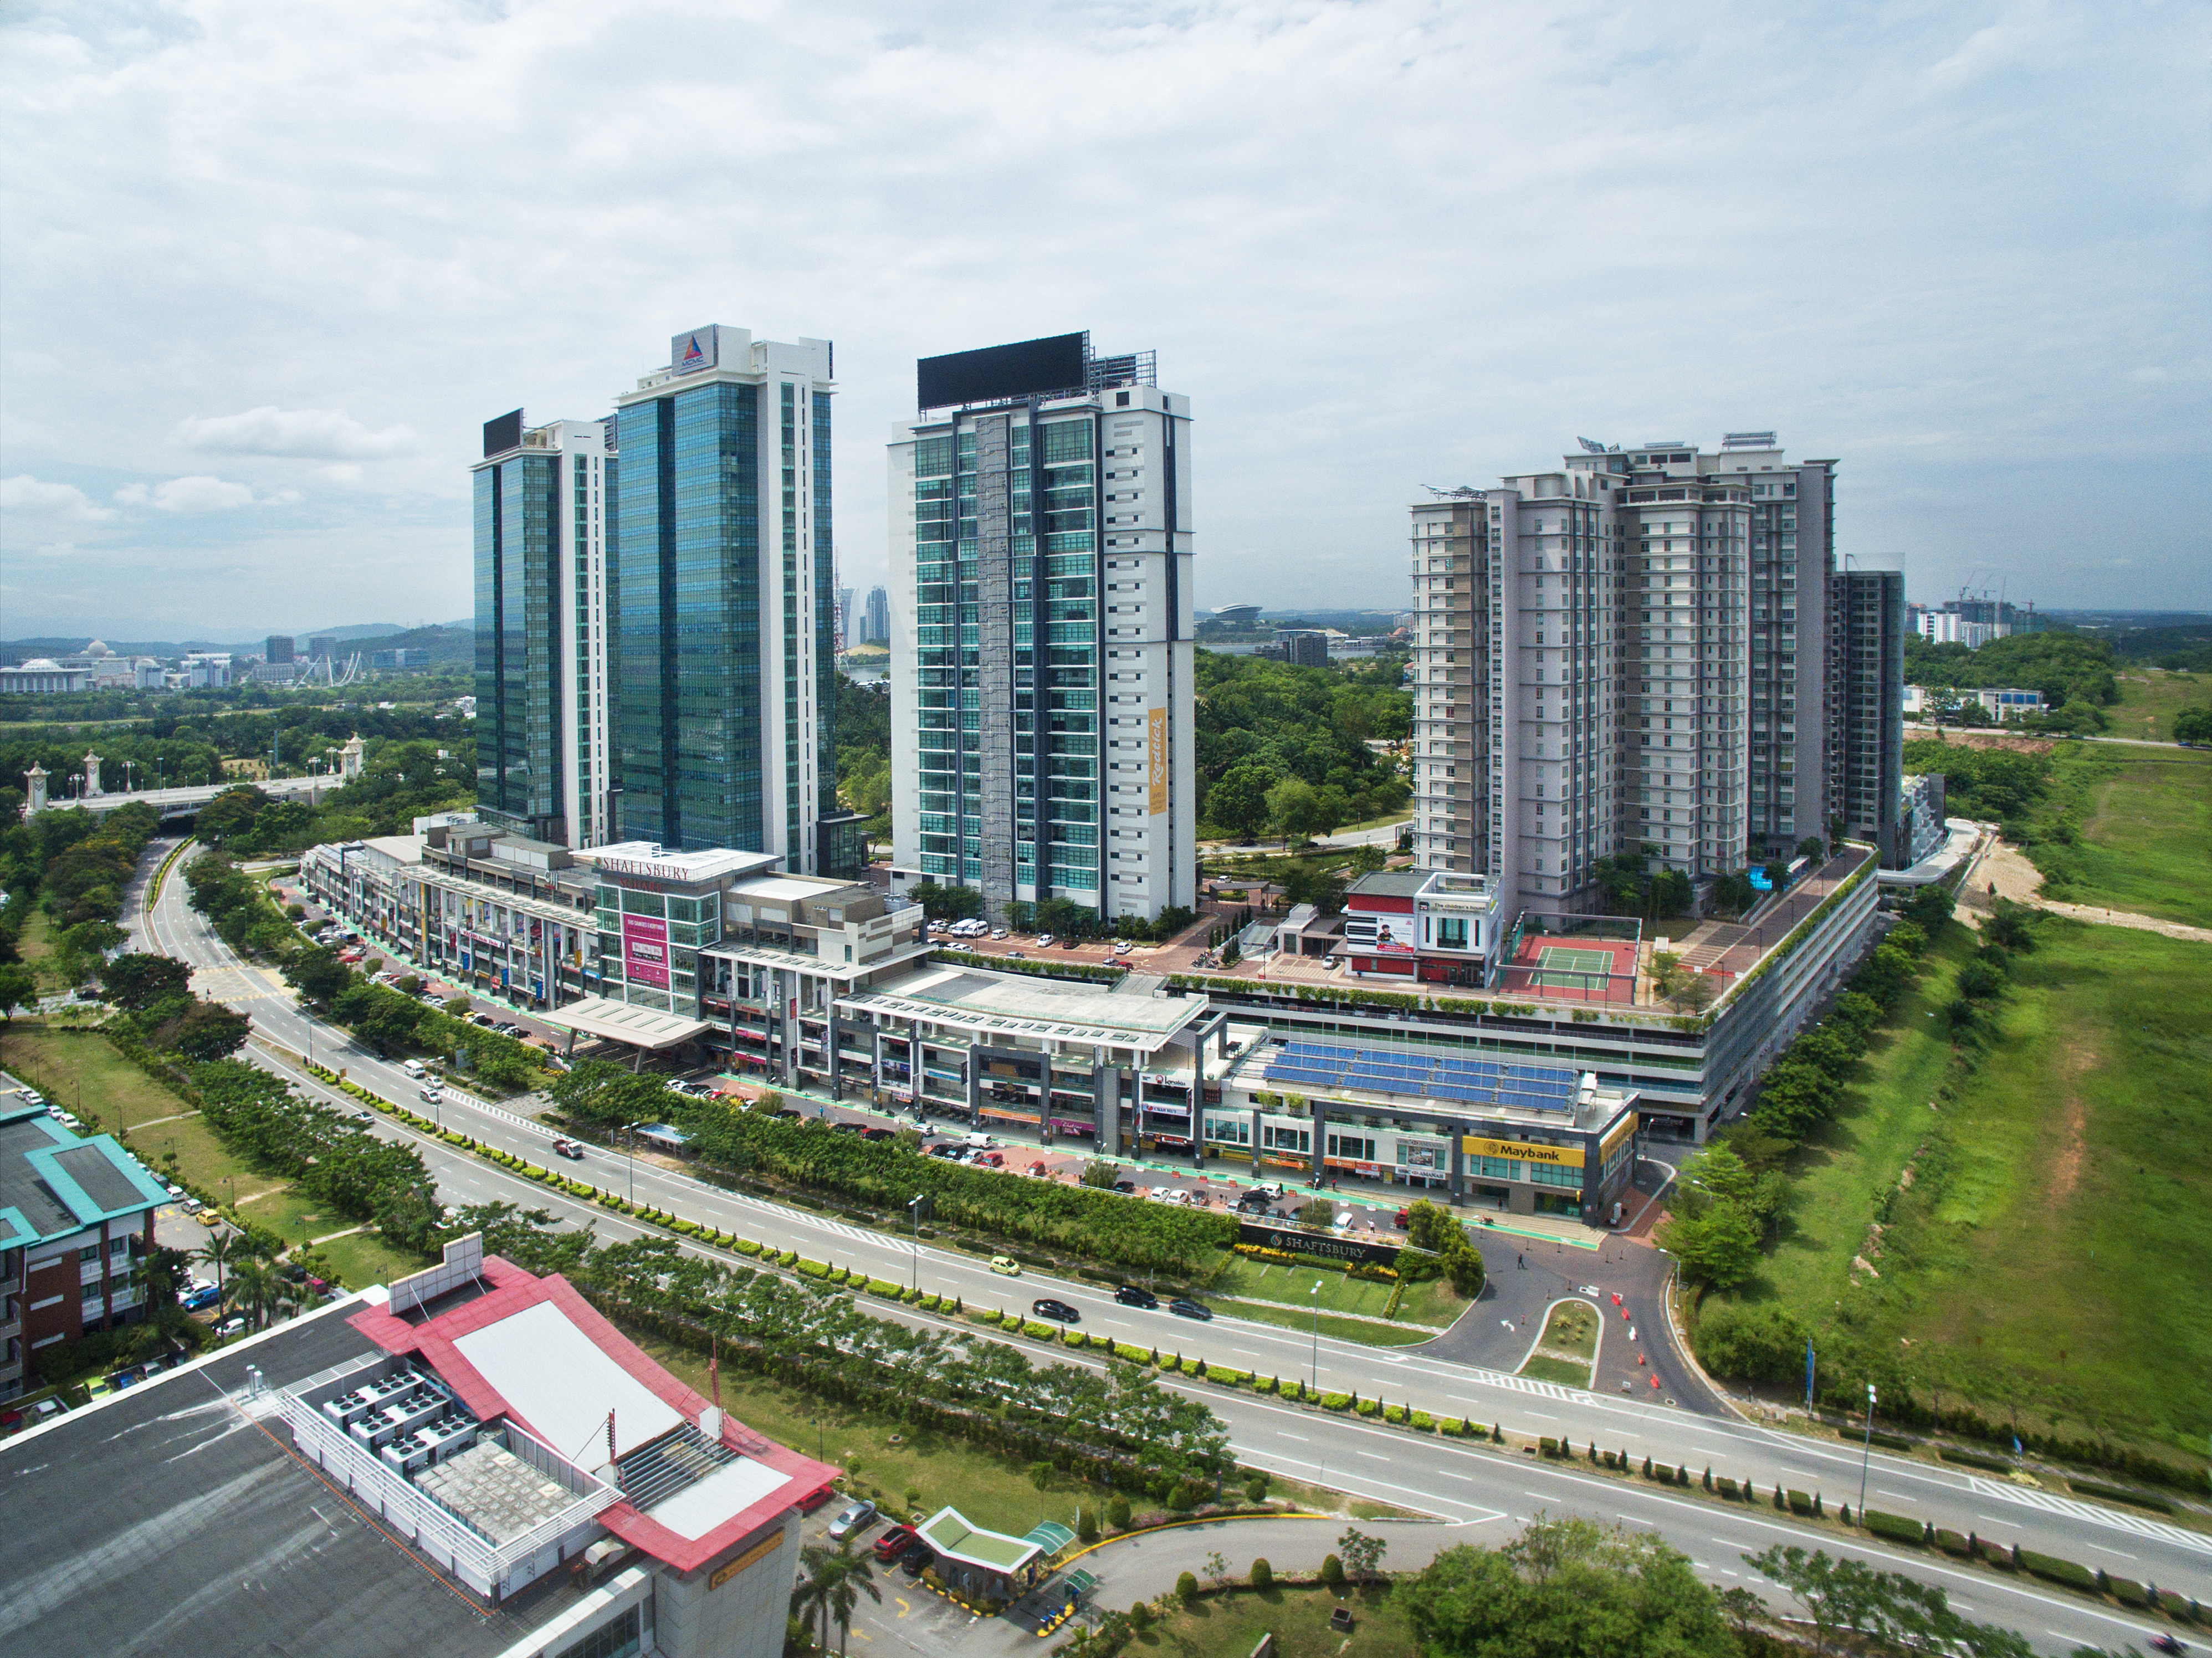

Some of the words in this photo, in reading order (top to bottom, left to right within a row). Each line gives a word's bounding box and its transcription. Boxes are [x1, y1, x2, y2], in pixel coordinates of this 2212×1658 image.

[682, 355, 704, 366] MCMC
[1151, 717, 1164, 786] Redtick
[619, 877, 662, 893] SQUARE
[1500, 1145, 1560, 1161] Maybank
[1286, 1237, 1366, 1258] SHAFTSBURY
